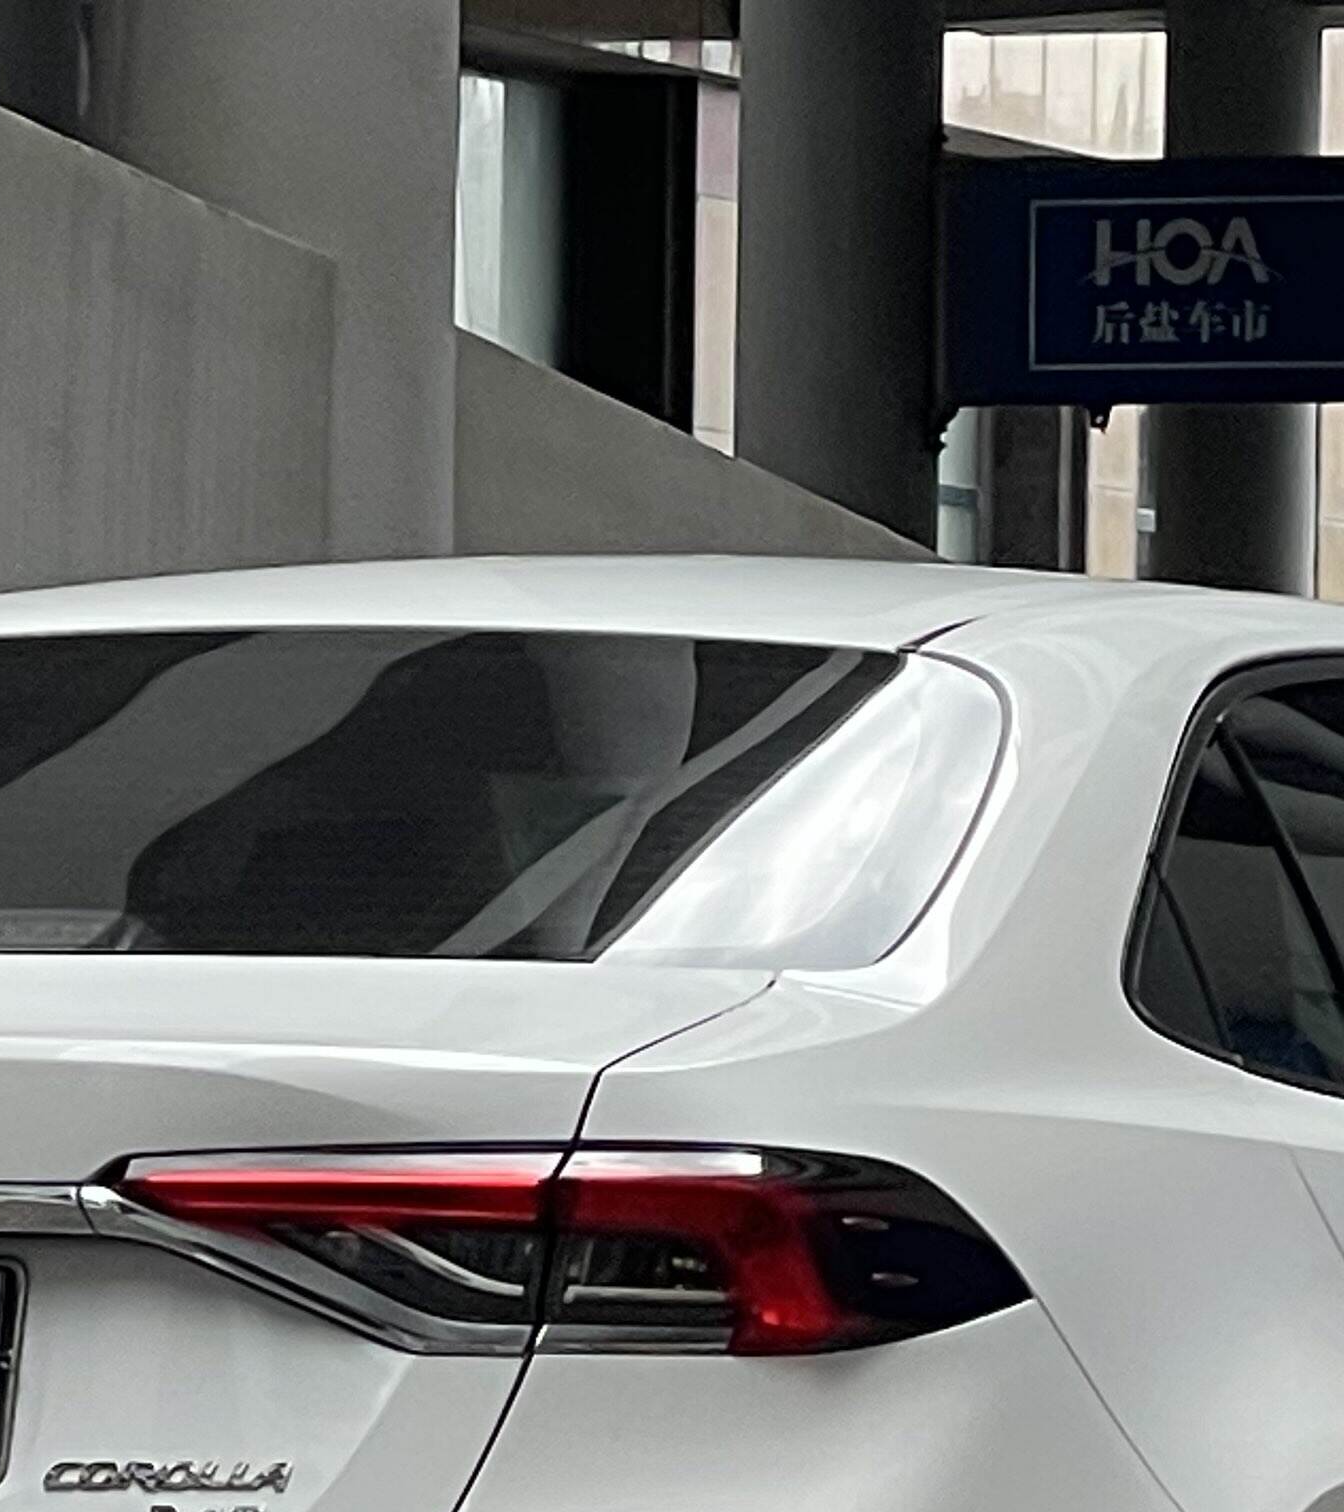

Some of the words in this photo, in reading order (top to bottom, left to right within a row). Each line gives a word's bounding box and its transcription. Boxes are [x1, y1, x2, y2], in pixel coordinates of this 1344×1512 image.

[1090, 216, 1274, 286] HOA
[1091, 300, 1271, 344] 后盐车市
[44, 1462, 292, 1493] COROLLA
